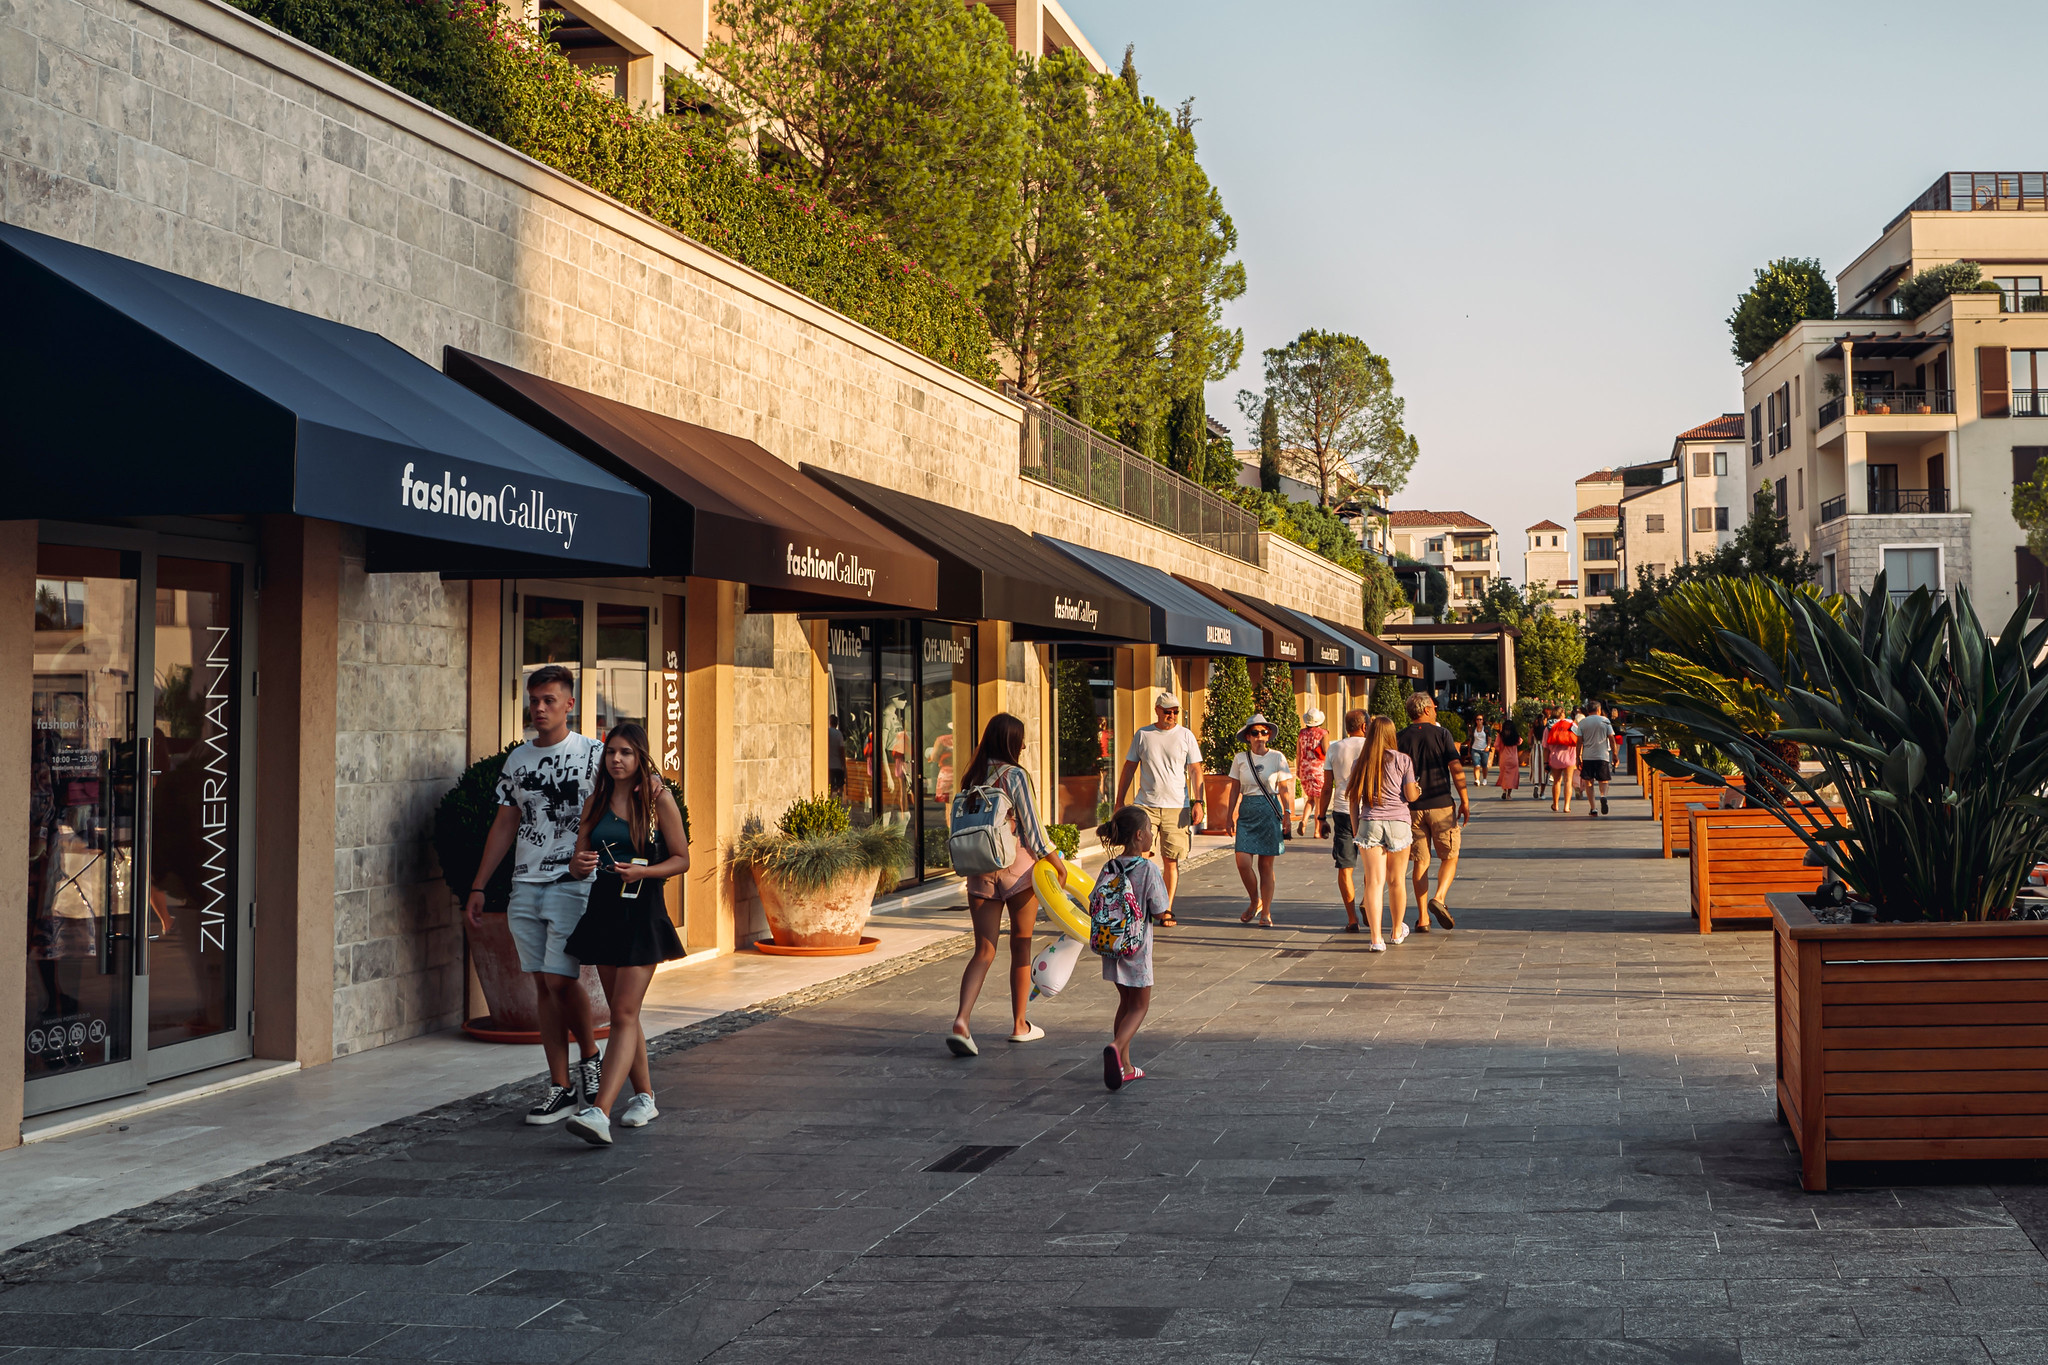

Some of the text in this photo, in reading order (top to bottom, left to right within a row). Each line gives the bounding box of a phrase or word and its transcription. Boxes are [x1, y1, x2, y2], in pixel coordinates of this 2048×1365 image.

[402, 462, 578, 550] fashionGallery
[786, 542, 876, 597] fashionGallery
[1054, 595, 1099, 630] fashionGallery
[663, 650, 682, 771] Angels
[79, 755, 98, 763] 23:00
[200, 626, 231, 954] ZIMMERMANN
